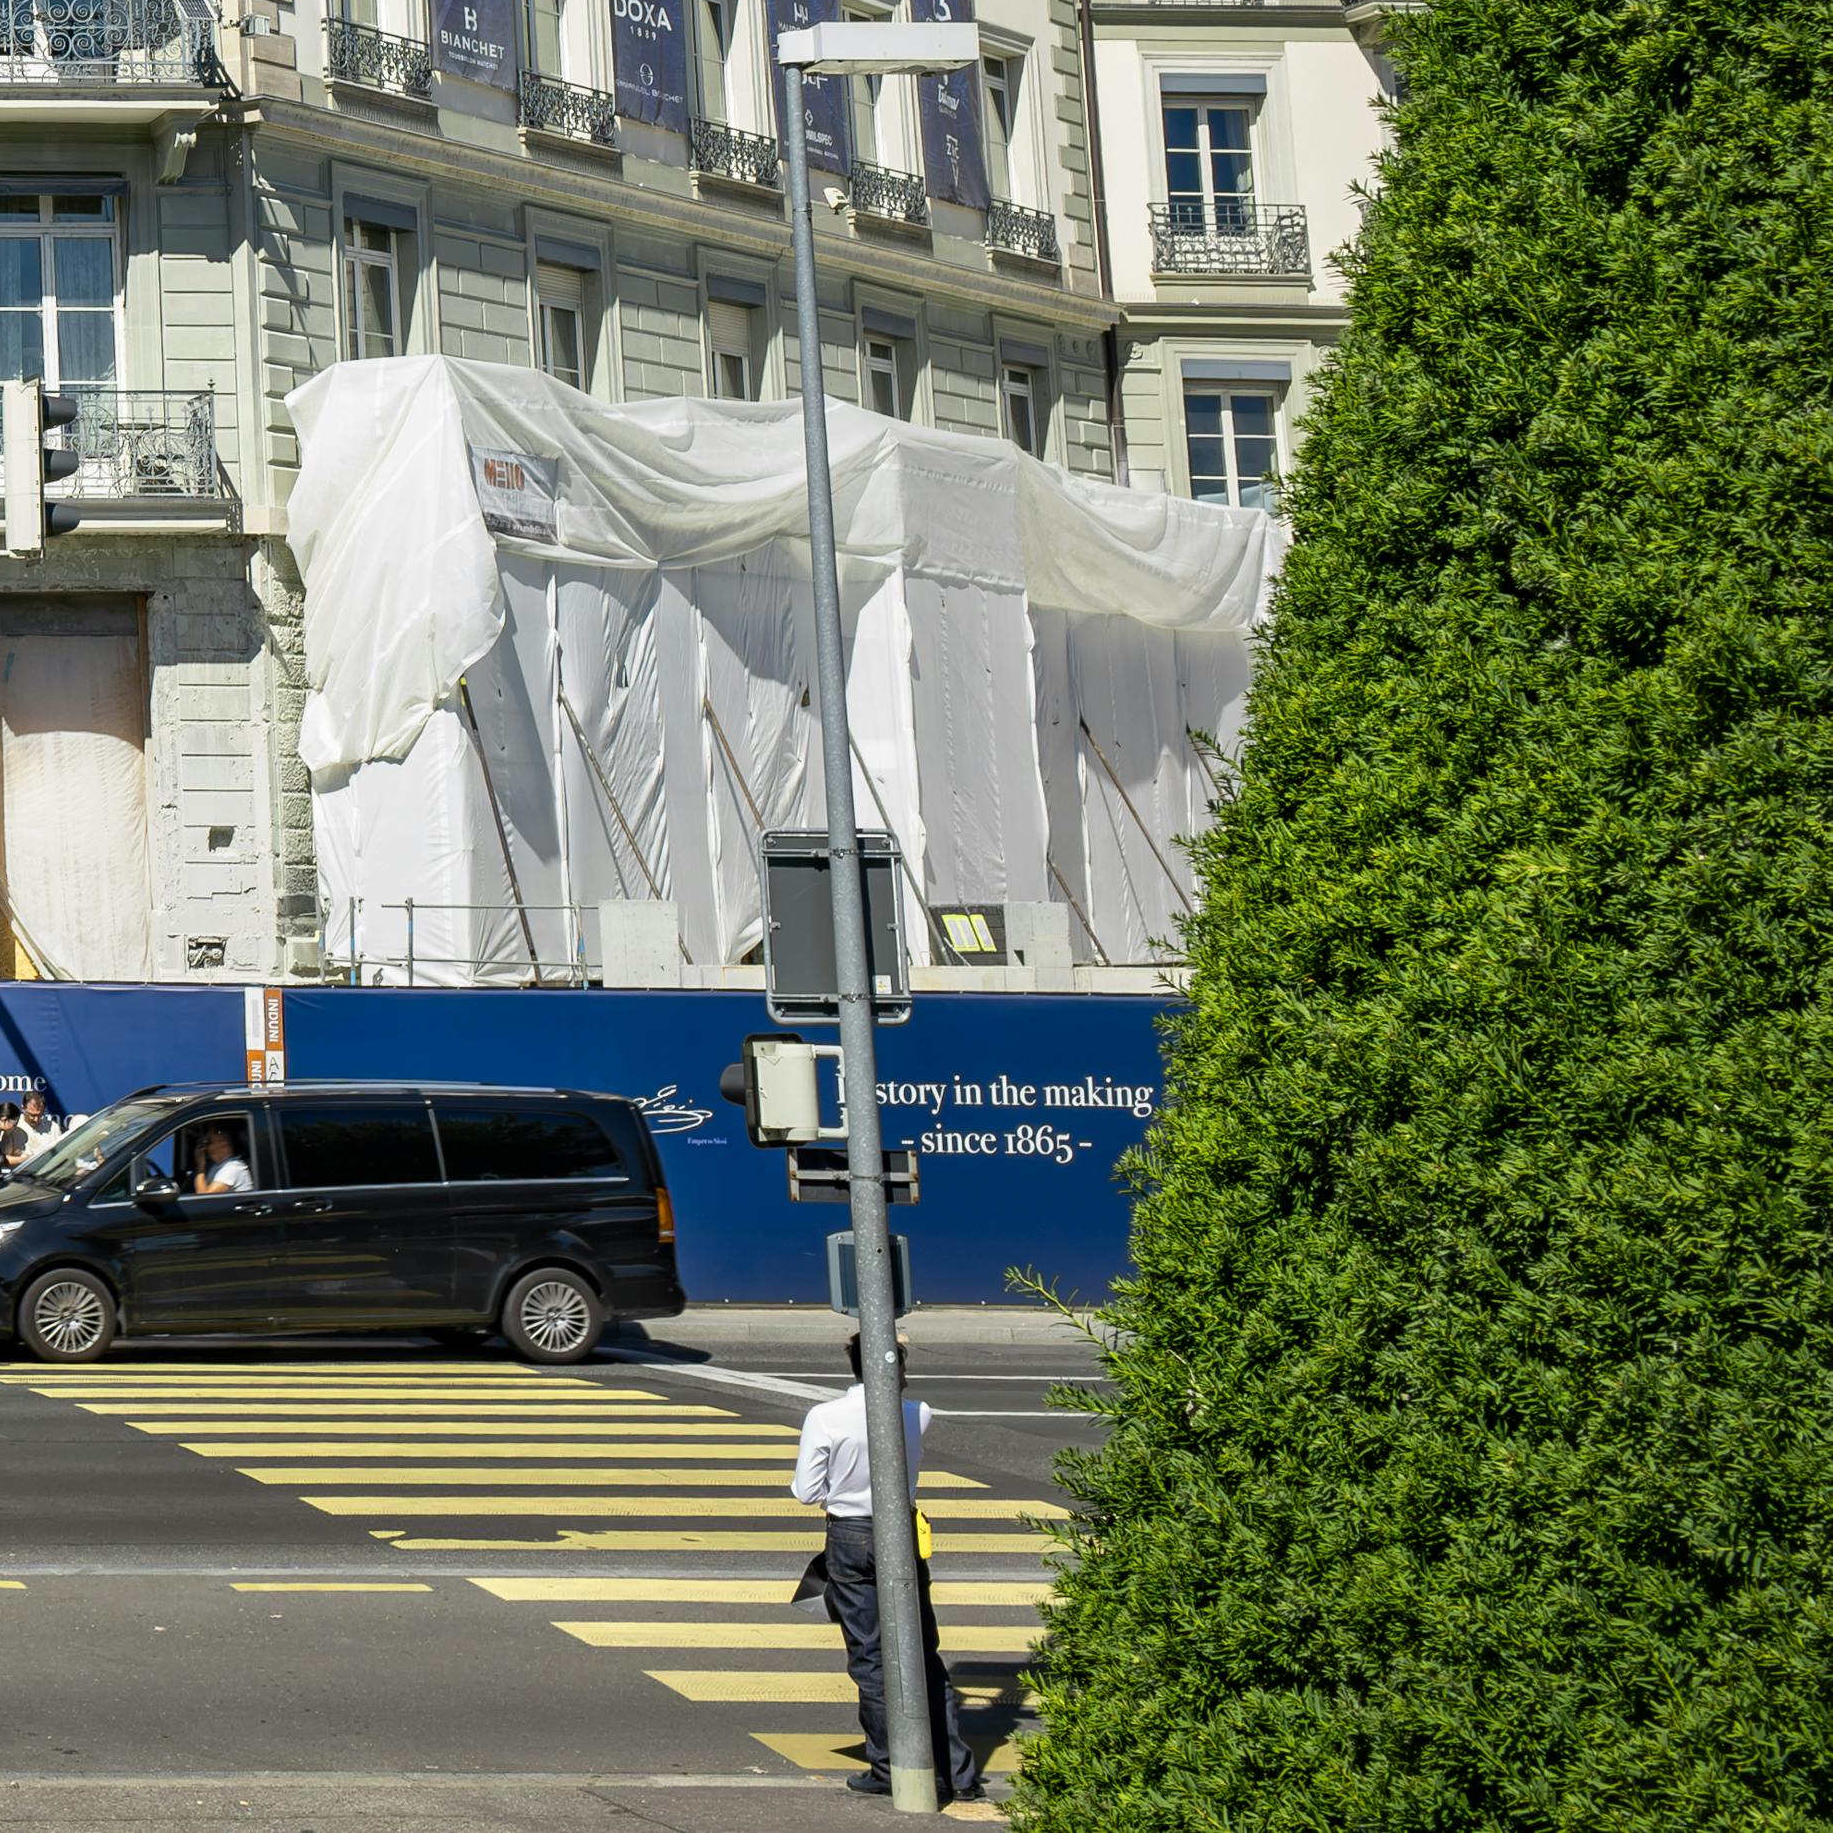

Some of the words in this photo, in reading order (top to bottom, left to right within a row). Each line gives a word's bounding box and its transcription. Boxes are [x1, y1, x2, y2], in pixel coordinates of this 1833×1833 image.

[441, 29, 505, 60] BIANCHET
[268, 998, 279, 1042] INDUNI
[953, 1075, 983, 1106] in
[989, 1075, 1036, 1107] the
[1043, 1076, 1155, 1118] making
[921, 1123, 997, 1154] since
[1004, 1124, 1074, 1165] 1865
